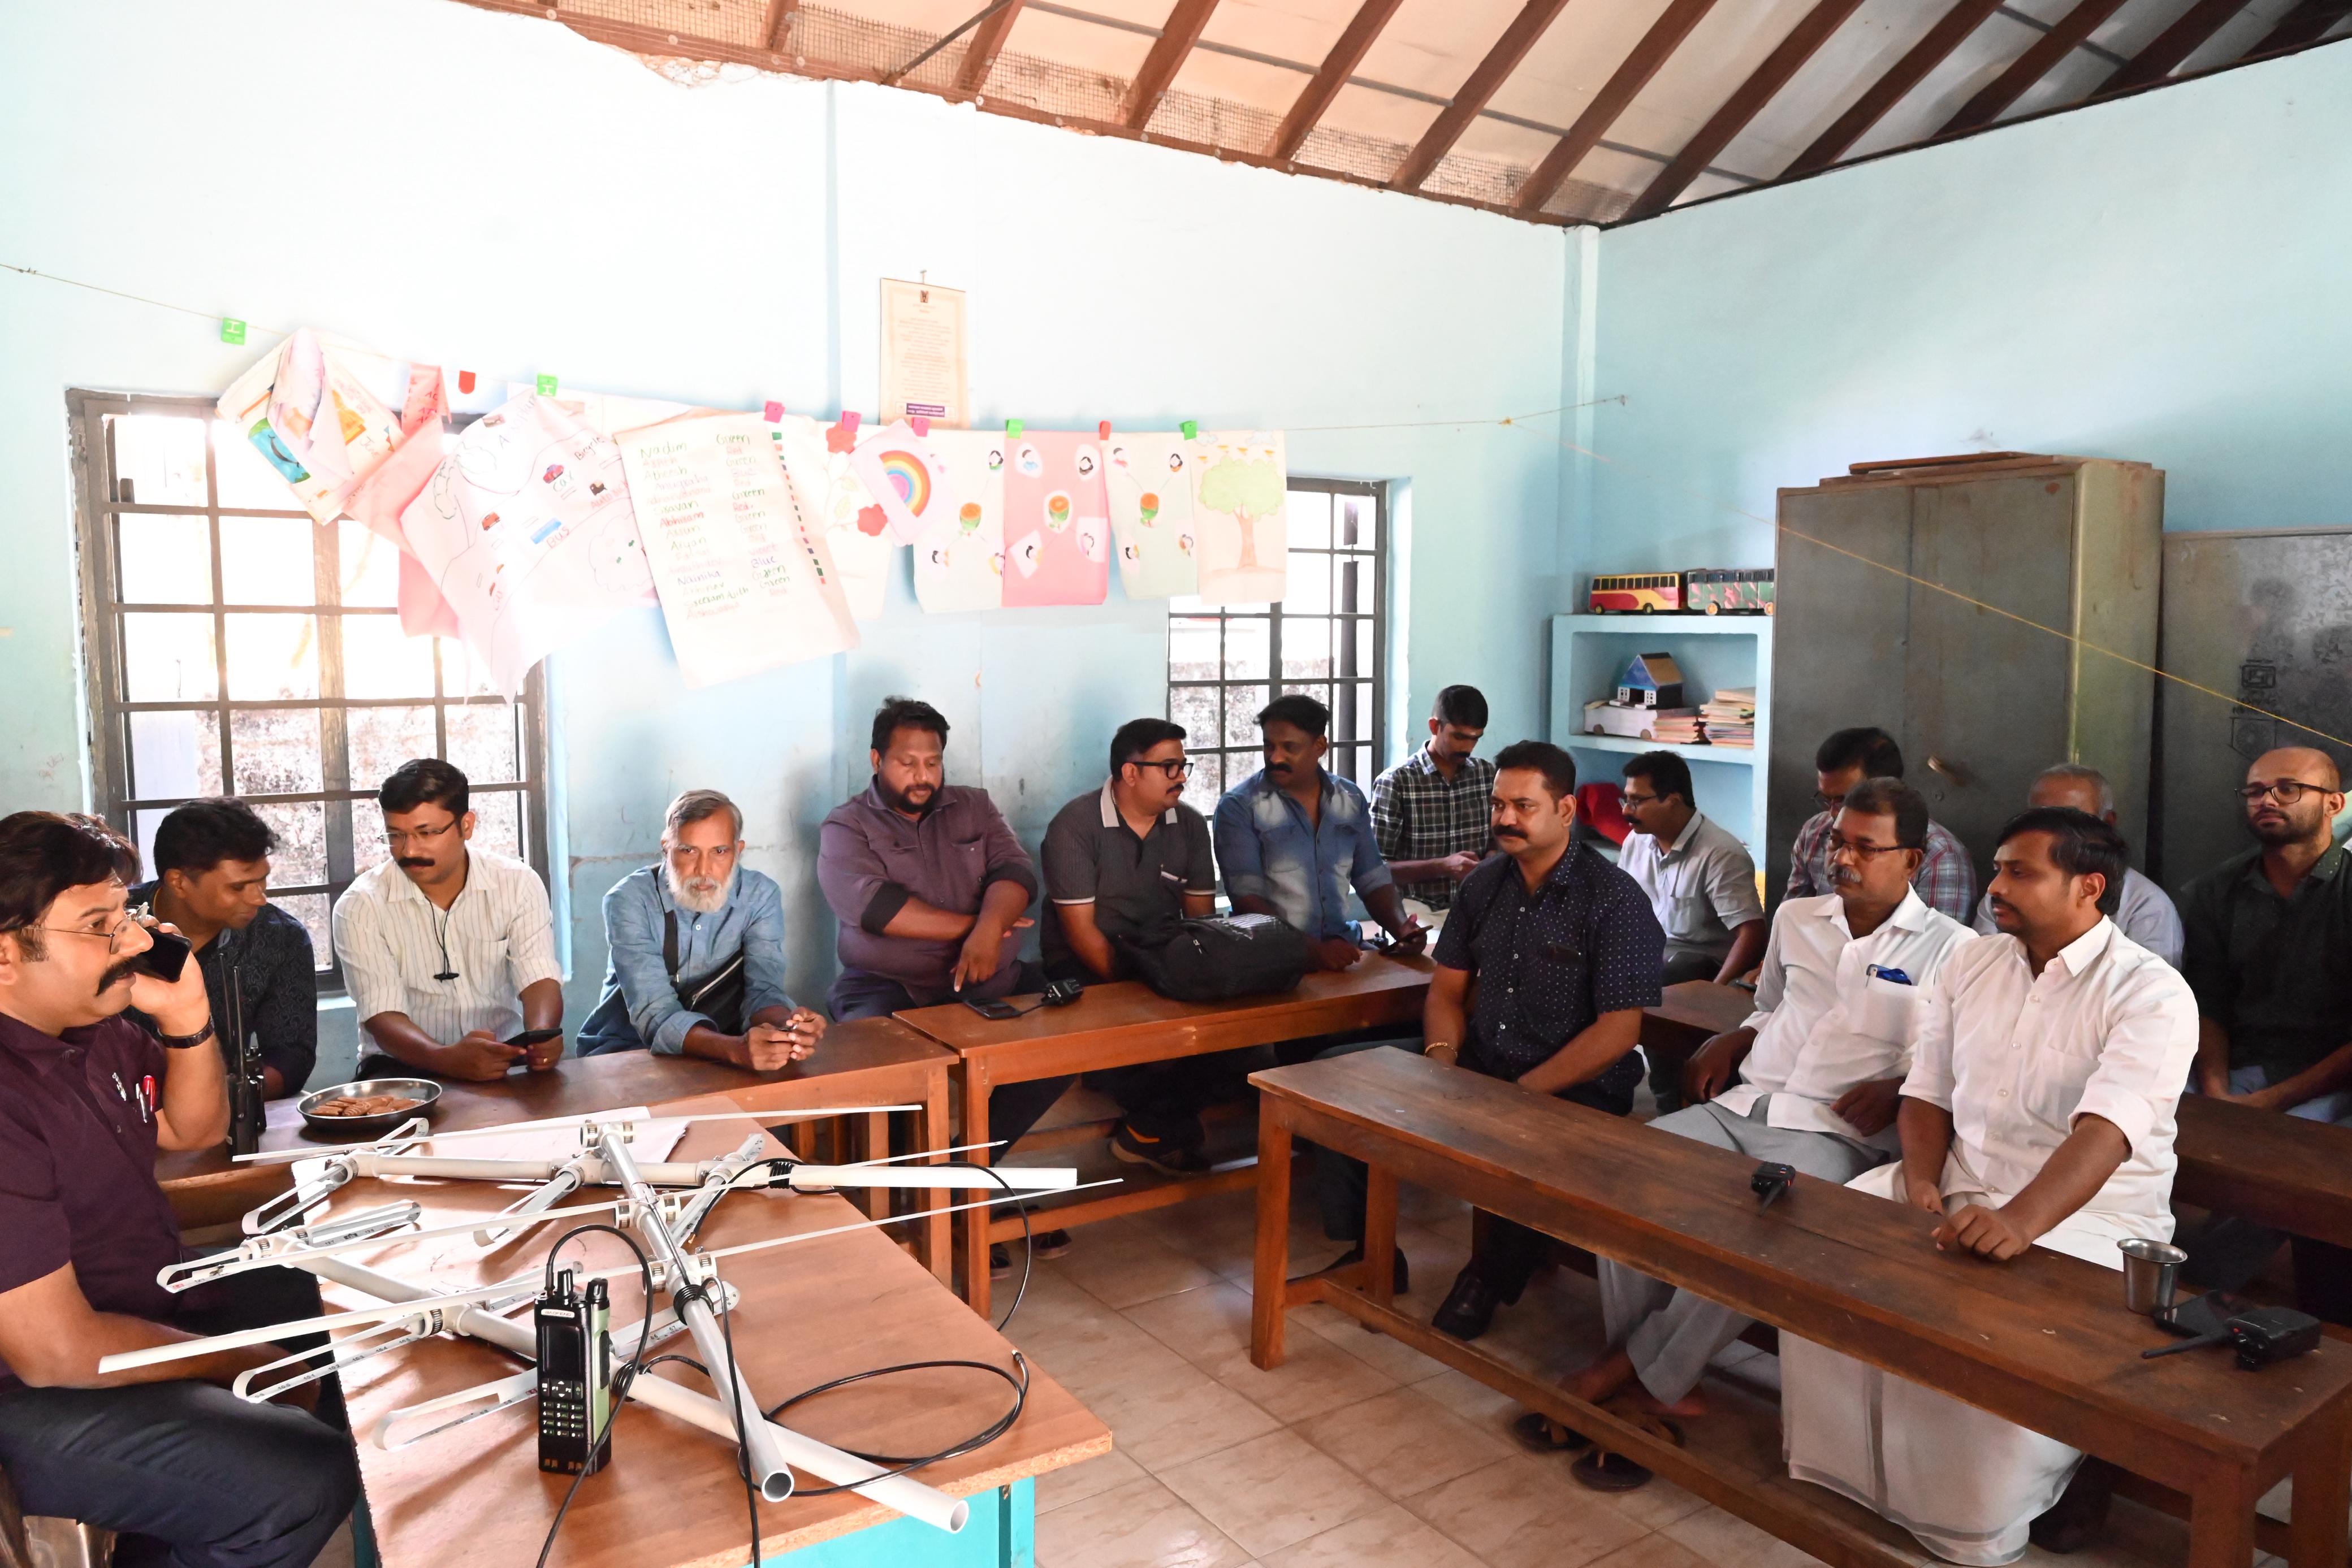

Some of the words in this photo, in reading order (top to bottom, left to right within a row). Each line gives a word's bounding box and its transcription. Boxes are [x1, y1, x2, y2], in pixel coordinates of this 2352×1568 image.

[640, 441, 688, 458] Nadim
[677, 570, 720, 586] Nainika
[751, 556, 778, 568] Blue
